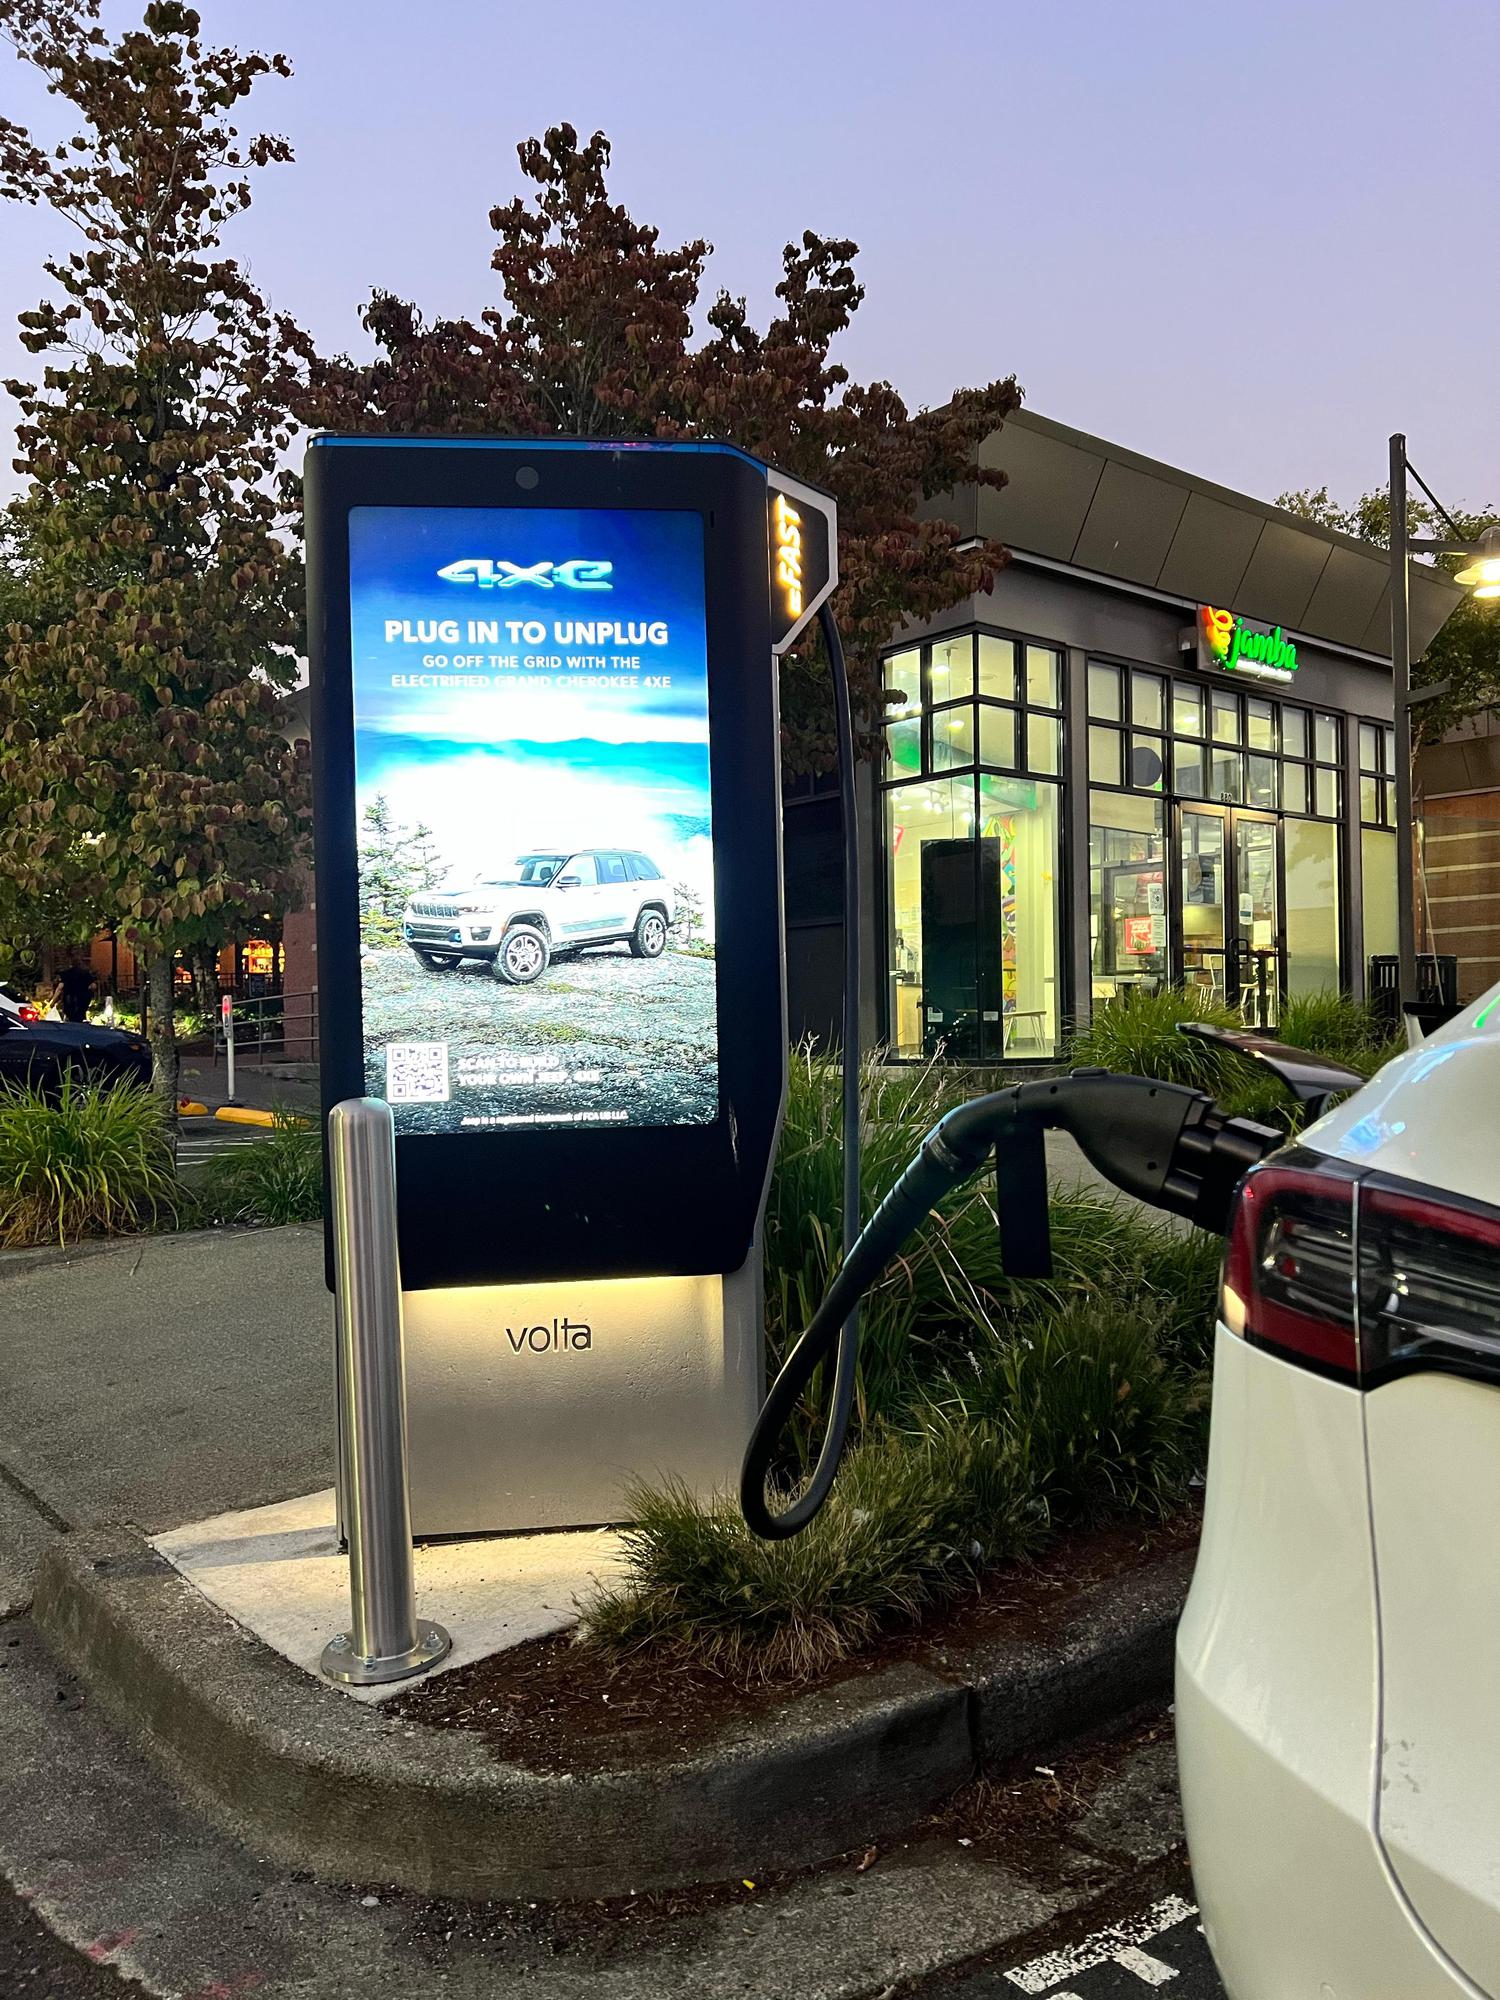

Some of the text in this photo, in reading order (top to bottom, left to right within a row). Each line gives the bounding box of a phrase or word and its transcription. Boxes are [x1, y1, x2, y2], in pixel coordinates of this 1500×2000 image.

[776, 493, 802, 590] FAST
[385, 620, 669, 645] PLUG IN TO UNPLUG
[1226, 618, 1299, 670] jamba
[423, 655, 640, 669] GO OFF THE GRID WITH THE
[391, 674, 671, 688] ELECTRIFIED GRAND CHEROKEE 4XE
[458, 1073, 497, 1086] YOUR
[499, 1072, 534, 1085] OWN
[505, 1317, 592, 1354] volta
